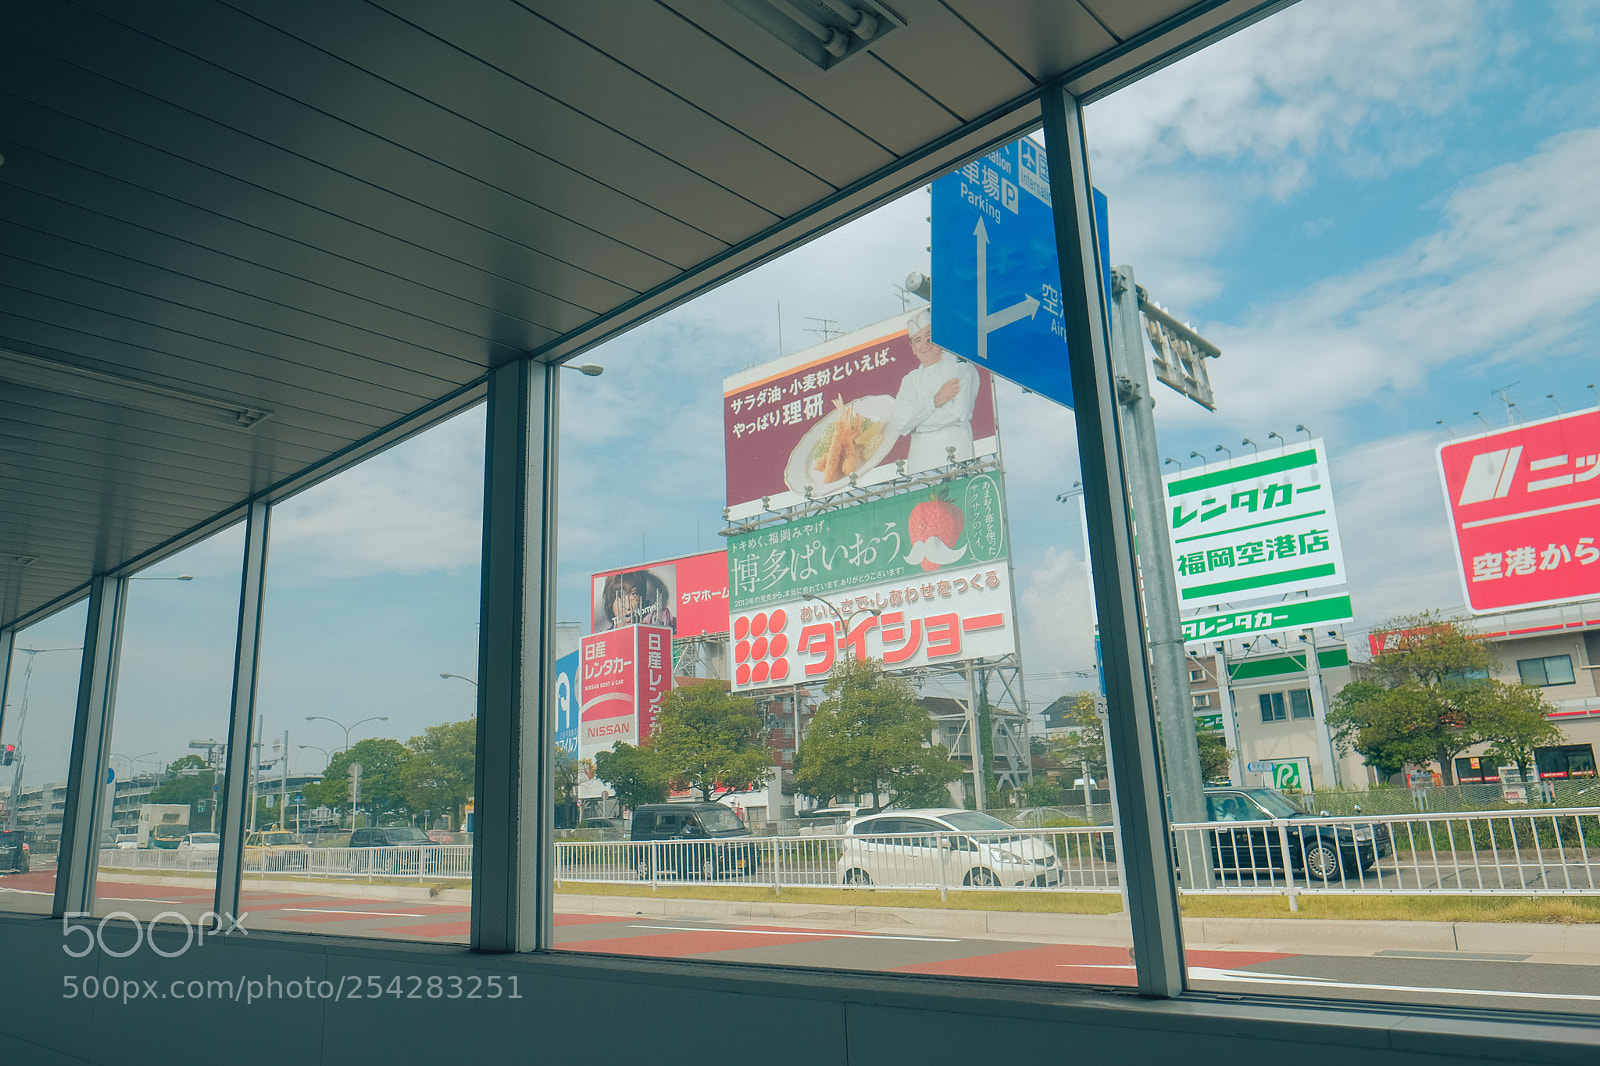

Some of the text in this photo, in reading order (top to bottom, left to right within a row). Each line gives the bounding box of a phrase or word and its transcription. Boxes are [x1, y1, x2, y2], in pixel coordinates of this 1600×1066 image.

[954, 161, 1000, 201] 車場
[960, 181, 1002, 225] Parking
[730, 347, 897, 416] サラダ油・小麦粉といえば、
[732, 392, 824, 439] やっぱり理研
[1172, 482, 1322, 530] レンタカー
[731, 521, 901, 597] 博多ぱいおう
[1176, 528, 1331, 577] 福岡空港店
[1472, 537, 1600, 583] 空港から
[681, 586, 730, 605] タマホーム
[799, 568, 1000, 621] おいしさで・しあわせをつくる
[585, 640, 607, 661] 日産
[796, 611, 1005, 676] ダイショー
[584, 656, 633, 681] レンタカー
[586, 721, 631, 739] NISSAN
